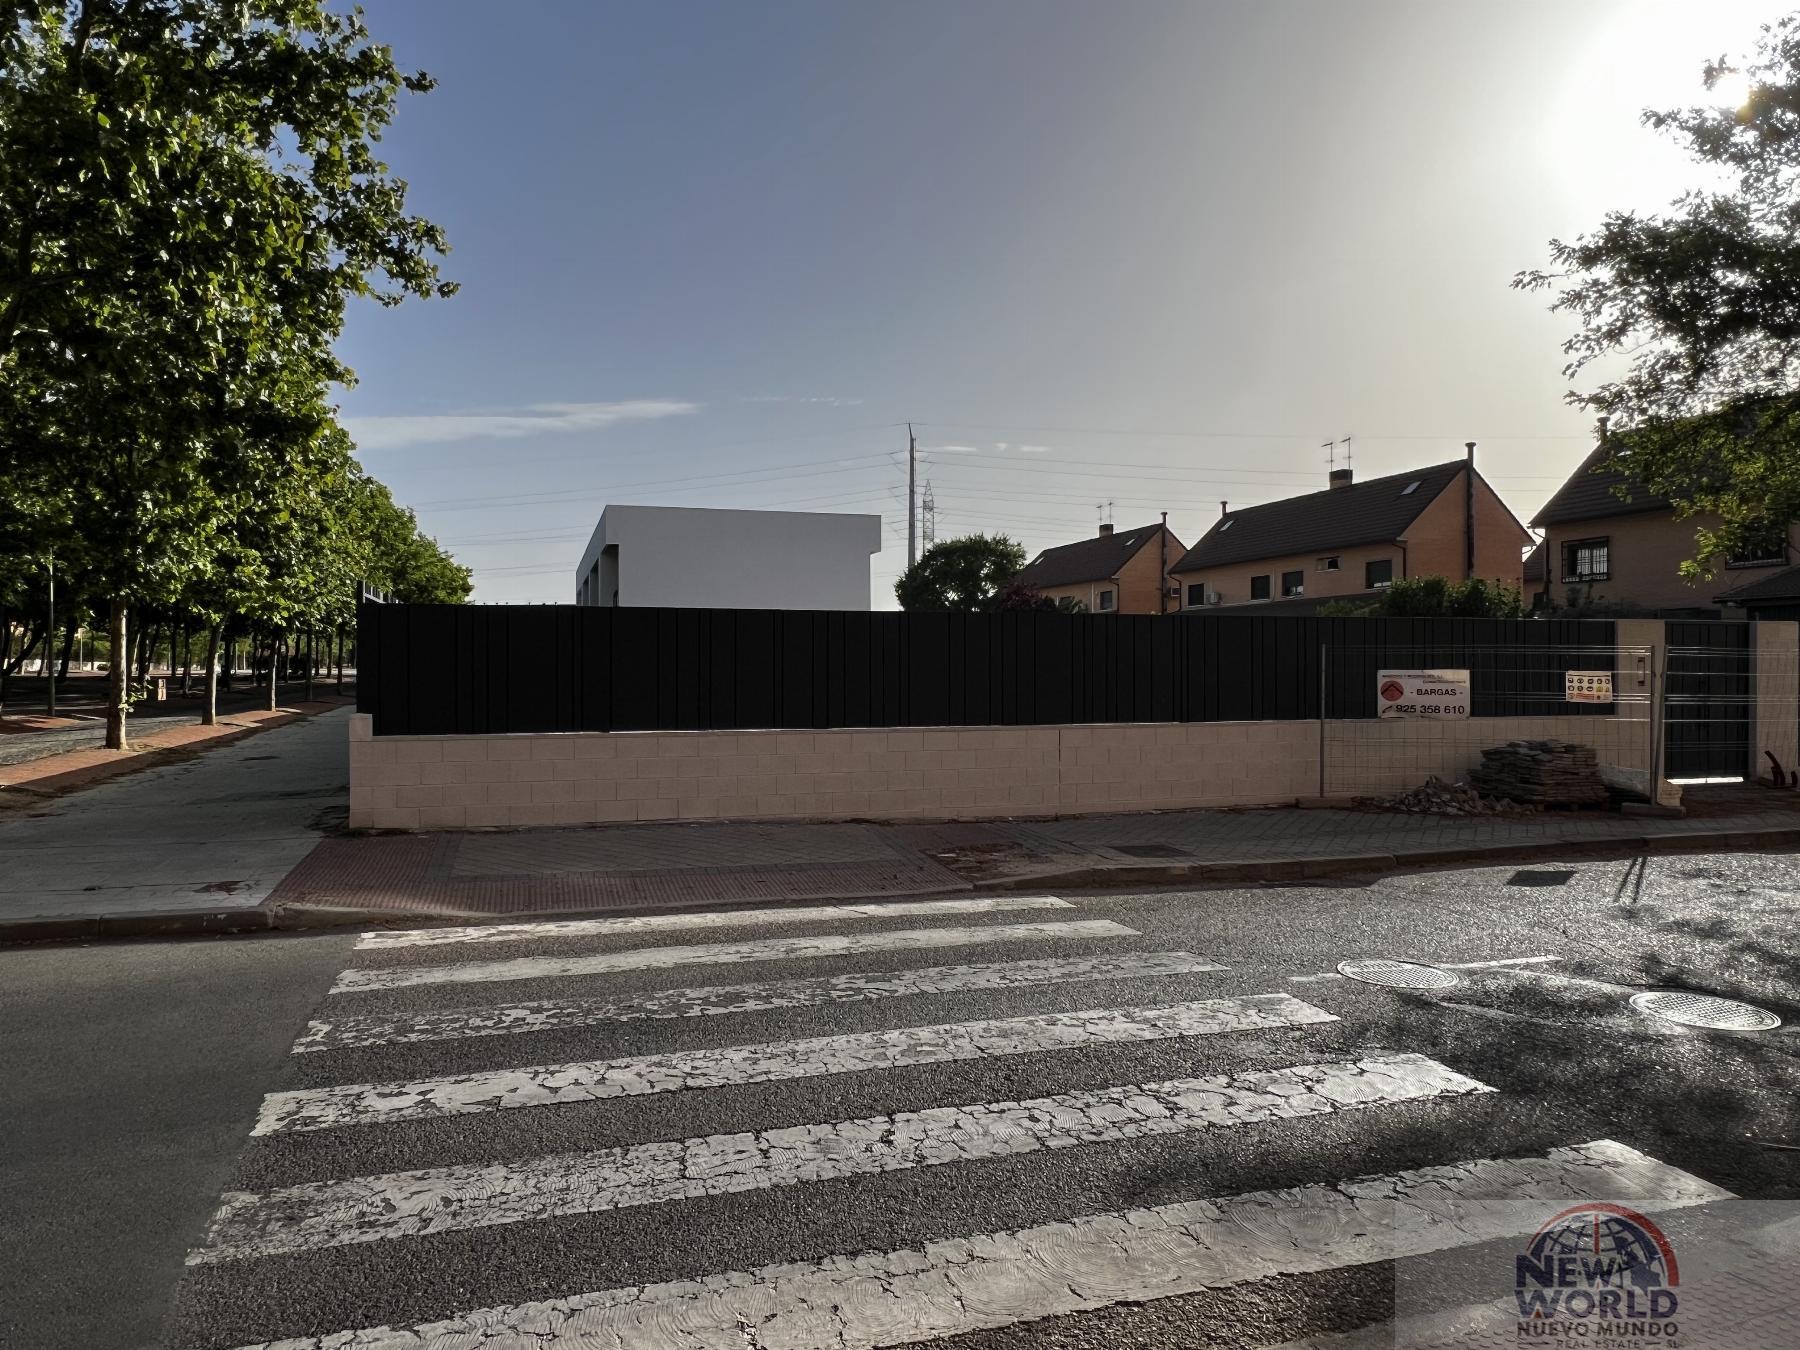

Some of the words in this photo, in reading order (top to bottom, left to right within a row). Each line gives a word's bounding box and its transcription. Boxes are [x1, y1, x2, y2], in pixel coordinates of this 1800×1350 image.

[1416, 688, 1457, 696] BARGAS
[1395, 704, 1417, 713] 925
[1420, 705, 1441, 714] 358
[1444, 705, 1465, 714] 610
